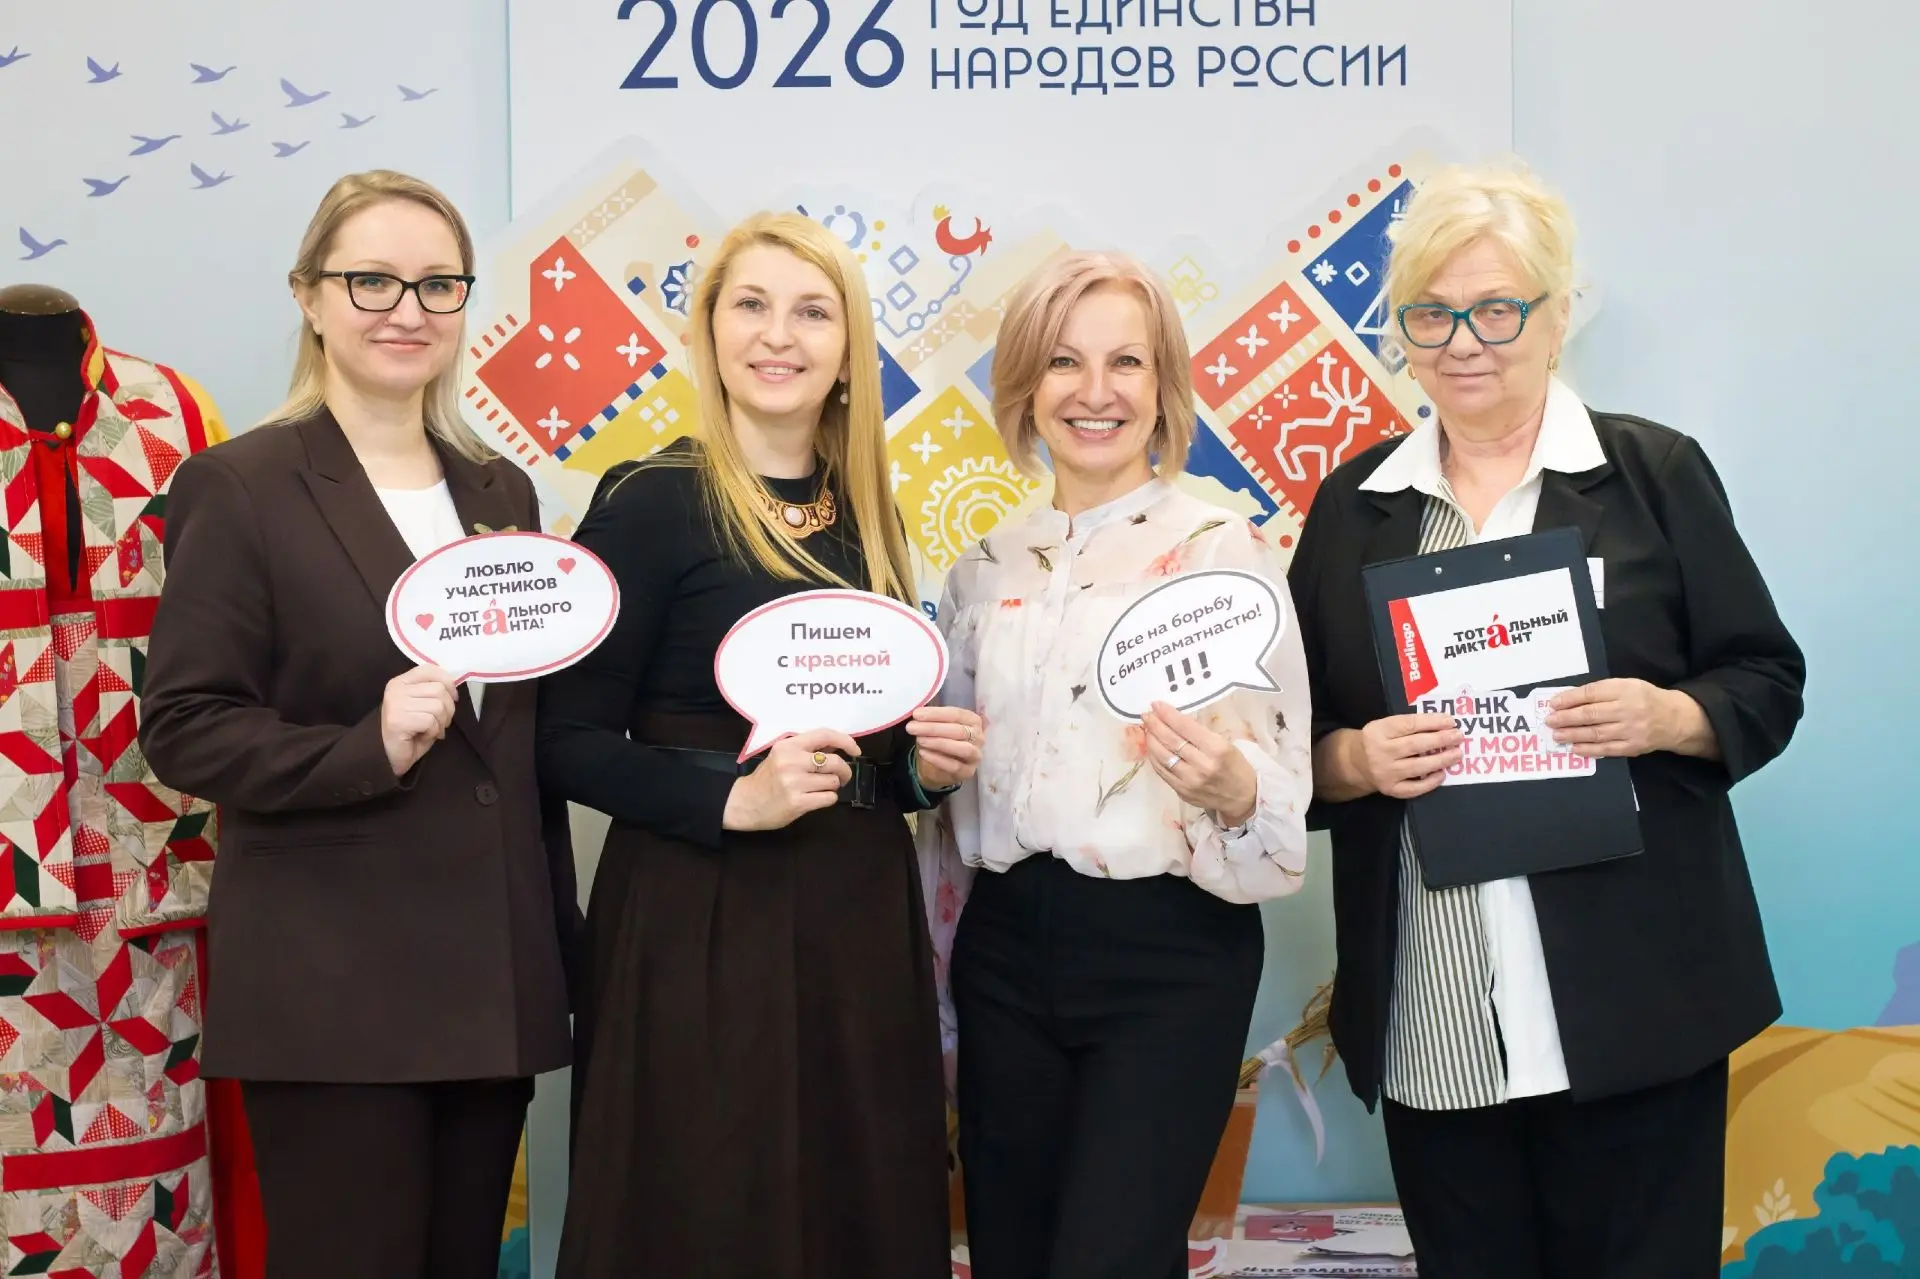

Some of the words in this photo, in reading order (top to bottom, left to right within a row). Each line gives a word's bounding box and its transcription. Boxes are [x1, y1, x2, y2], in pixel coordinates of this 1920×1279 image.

[617, 0, 905, 90] 2026
[931, 46, 1175, 96] НАРОДОВ
[1198, 44, 1407, 88] РОССИИ
[464, 560, 534, 579] ЛЮБЛЮ
[445, 577, 558, 600] УЧАСТНИКОВ
[790, 623, 871, 641] Пишем
[1115, 633, 1144, 656] Все
[1147, 622, 1169, 640] на
[1171, 594, 1234, 628] борьбу
[1109, 674, 1117, 686] с
[1118, 602, 1262, 679] бизграматнастю!
[1402, 622, 1421, 682] Berlingo
[777, 655, 788, 668] с
[794, 650, 891, 672] красной
[1165, 651, 1211, 693] !!!
[785, 681, 883, 700] строки...
[1480, 734, 1539, 755] МОИ
[1446, 752, 1590, 776] ОКУМЕНТЫ
